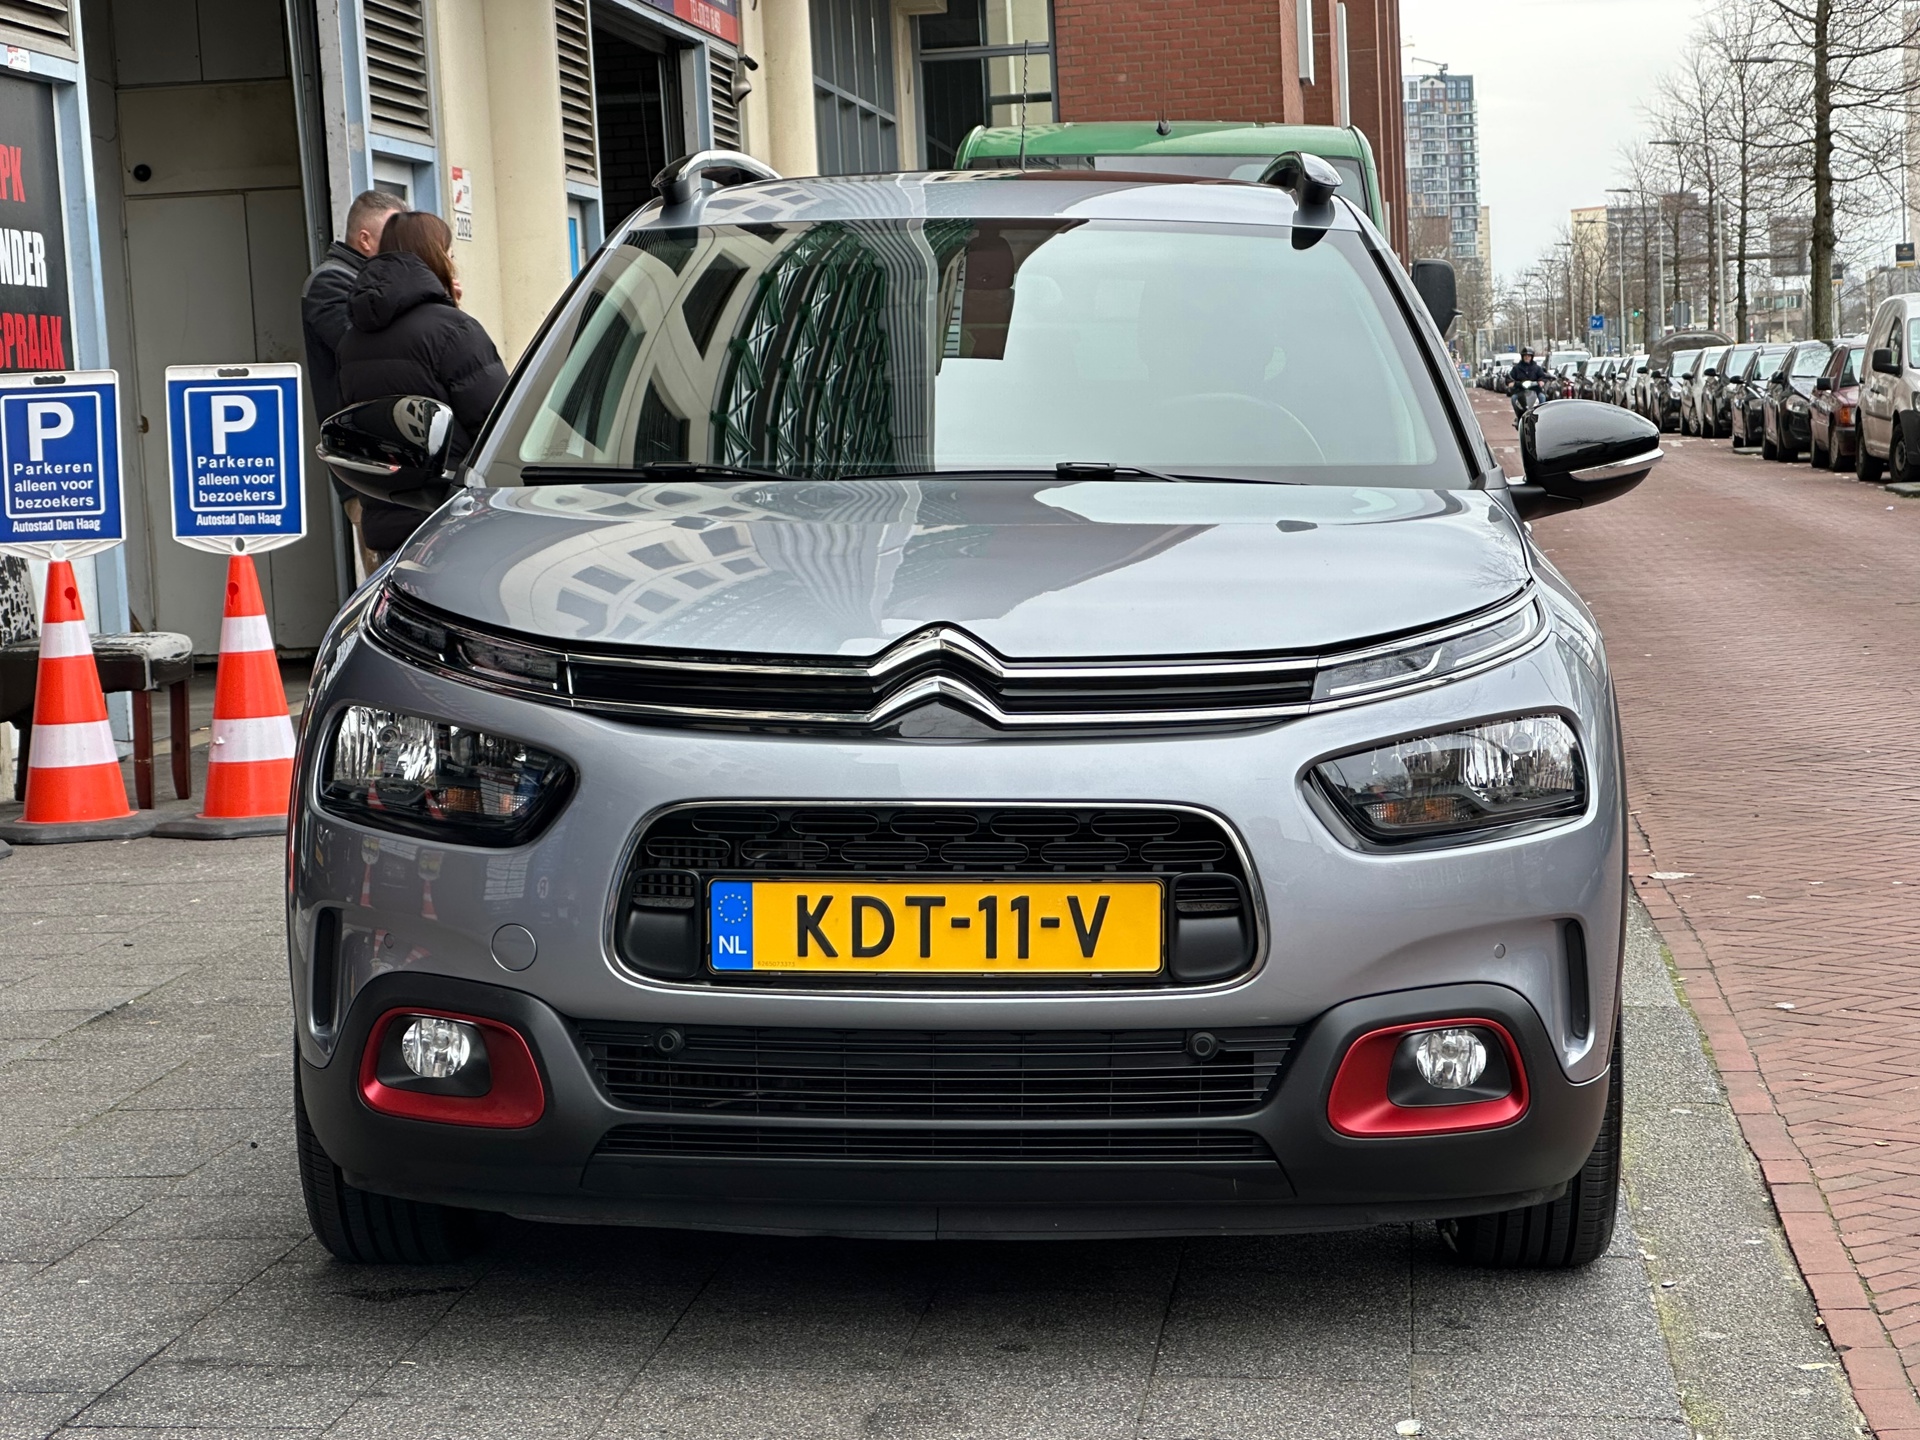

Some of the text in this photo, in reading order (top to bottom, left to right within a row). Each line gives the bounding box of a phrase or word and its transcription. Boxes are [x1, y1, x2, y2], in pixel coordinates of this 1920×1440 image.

[0, 144, 26, 203] PK
[27, 401, 74, 462] P
[210, 394, 258, 455] P
[13, 462, 93, 475] Parkeren
[197, 456, 275, 469] Parkeren
[14, 478, 93, 492] alleen voor
[198, 473, 275, 485] alleen voor
[15, 495, 94, 509] bezoekers
[199, 490, 275, 503] bezoekers
[12, 518, 100, 533] Autostad Den Haag
[196, 513, 282, 526] Autostad Den Haag
[796, 895, 1111, 959] KDT-11-V
[717, 936, 748, 955] NL
